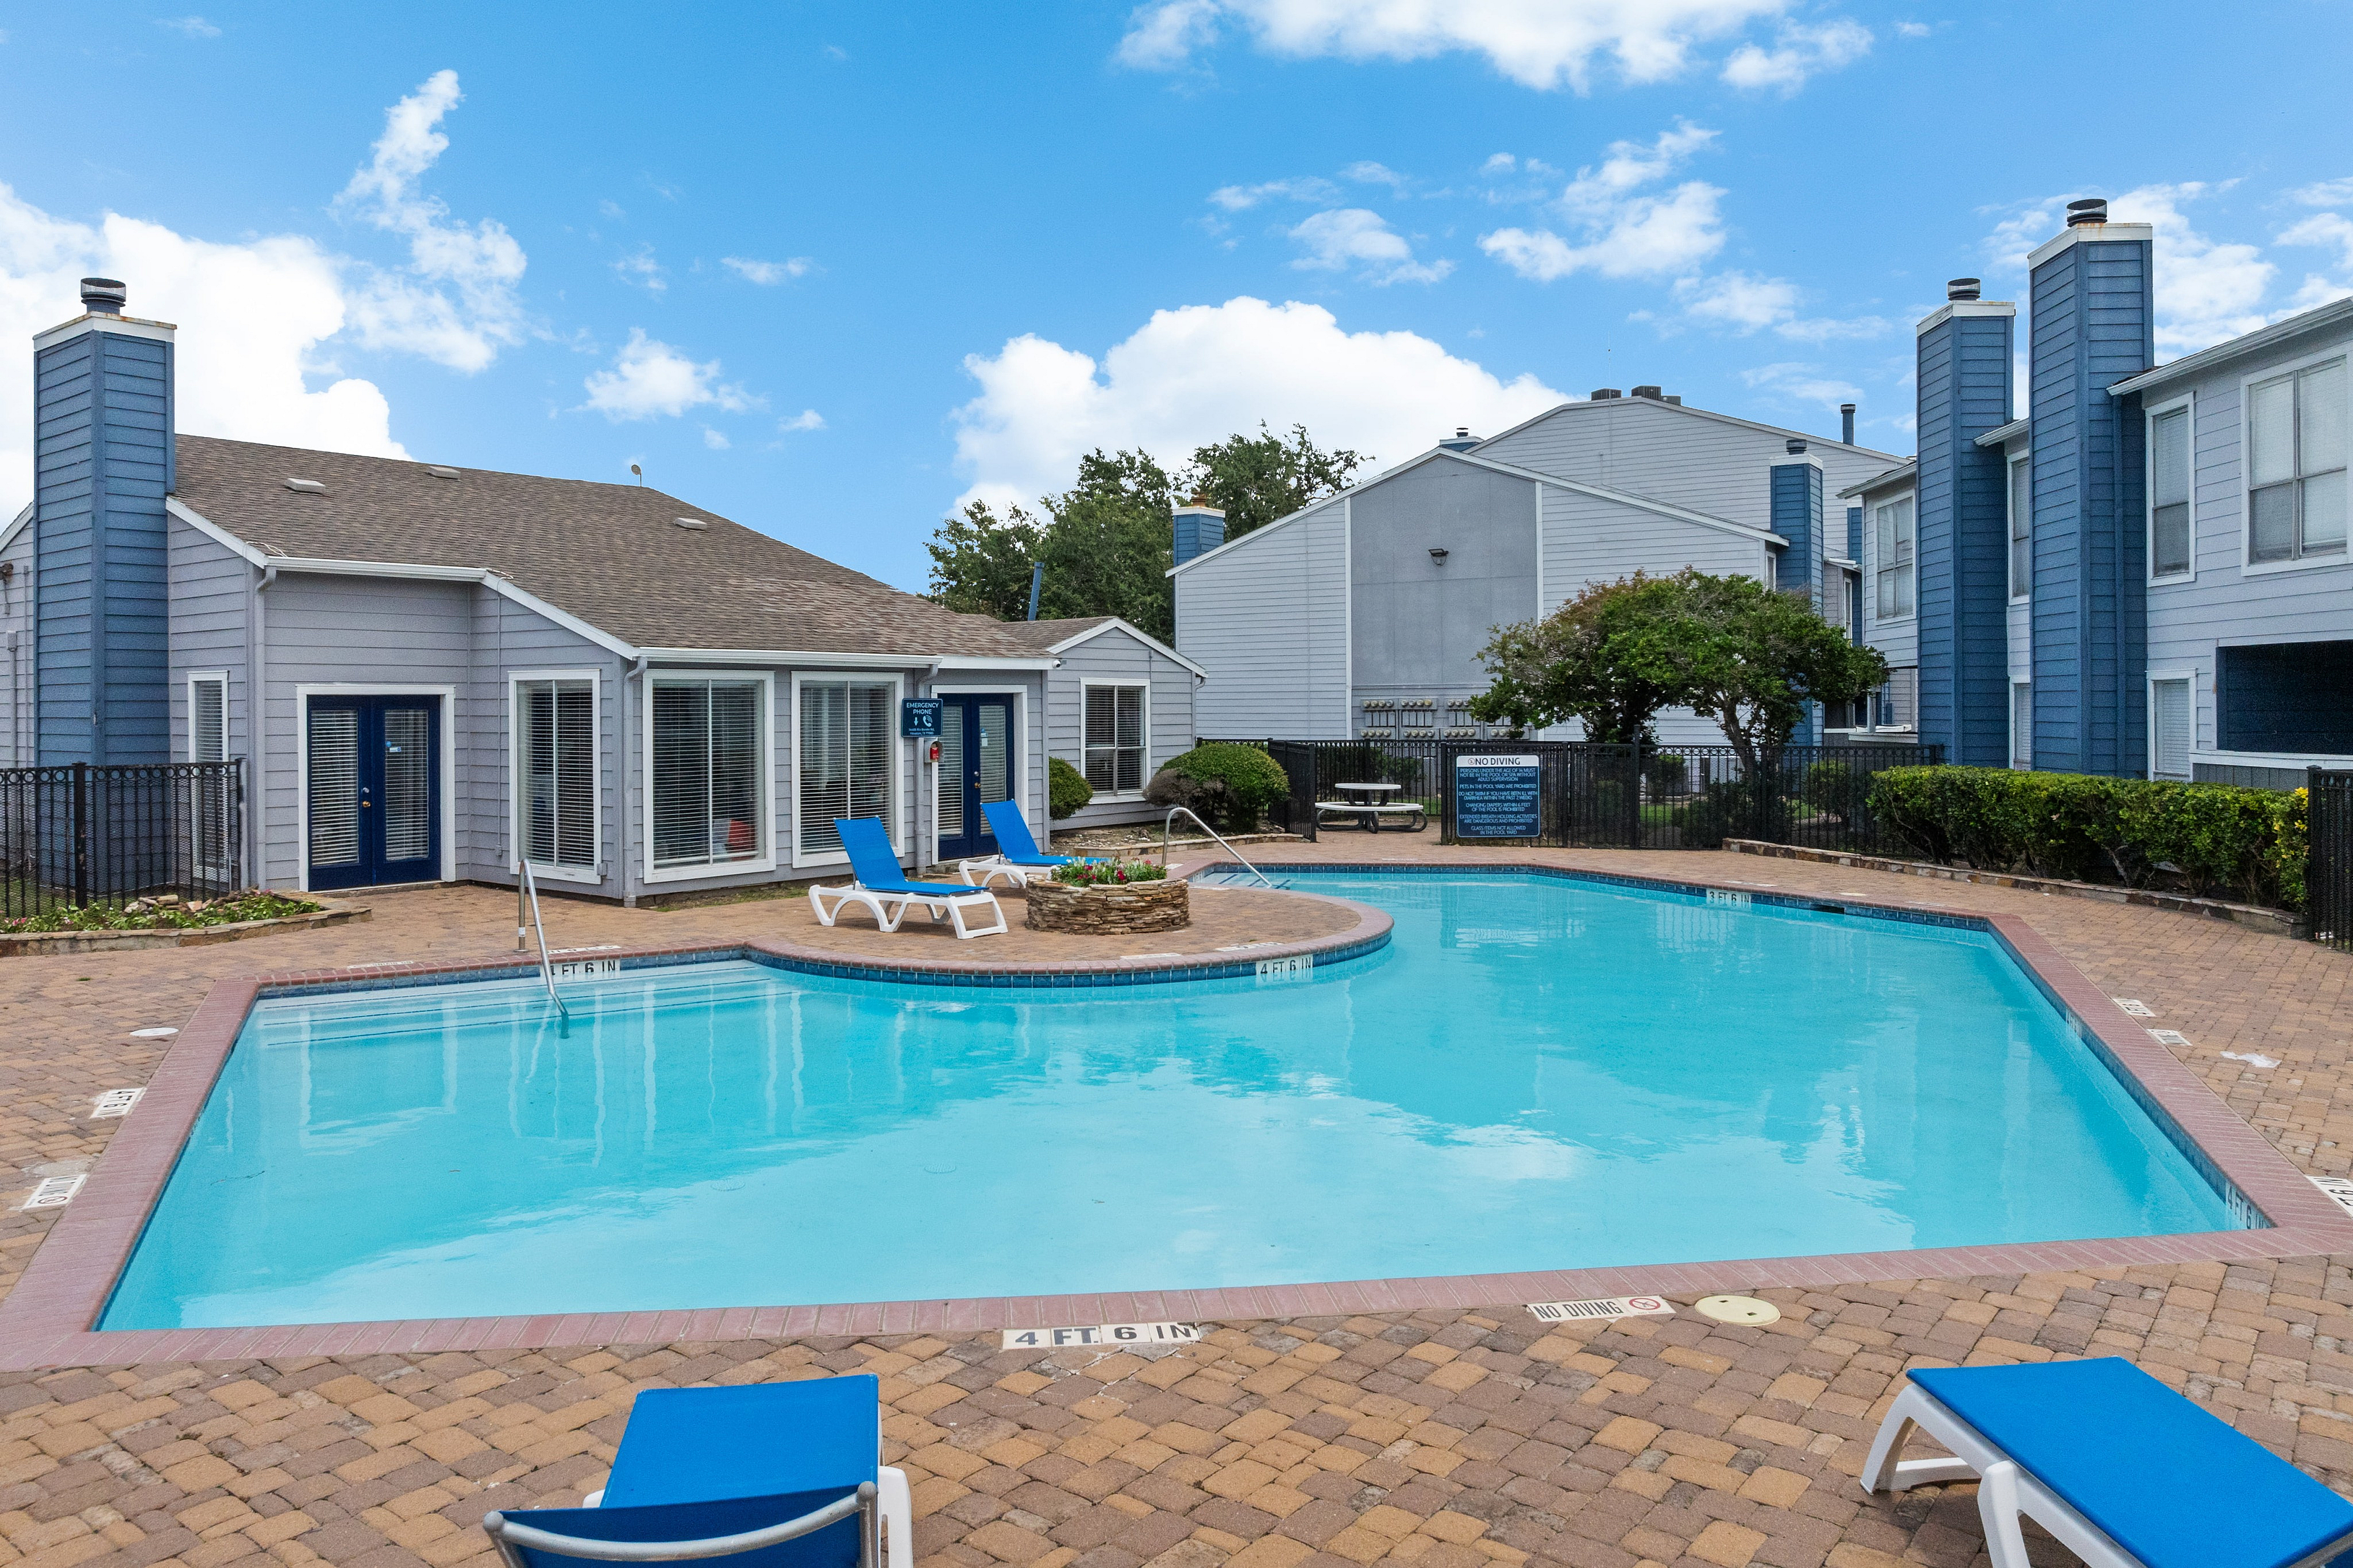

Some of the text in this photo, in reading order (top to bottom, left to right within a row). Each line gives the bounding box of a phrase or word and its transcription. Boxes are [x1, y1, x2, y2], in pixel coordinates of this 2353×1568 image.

[1719, 892, 1727, 900] FT
[1741, 894, 1749, 902] IN
[562, 964, 578, 975] FT
[585, 962, 594, 972] 6
[602, 960, 615, 971] IN
[1260, 957, 1311, 974] 4 FT 6 IN
[2228, 1186, 2232, 1209] 4
[2235, 1191, 2243, 1221] FT
[2247, 1204, 2251, 1229] 6
[1533, 1300, 1623, 1319] NO DIVING
[1015, 1331, 1039, 1346] 4
[1114, 1327, 1137, 1339] 6
[1155, 1325, 1191, 1339] IN
